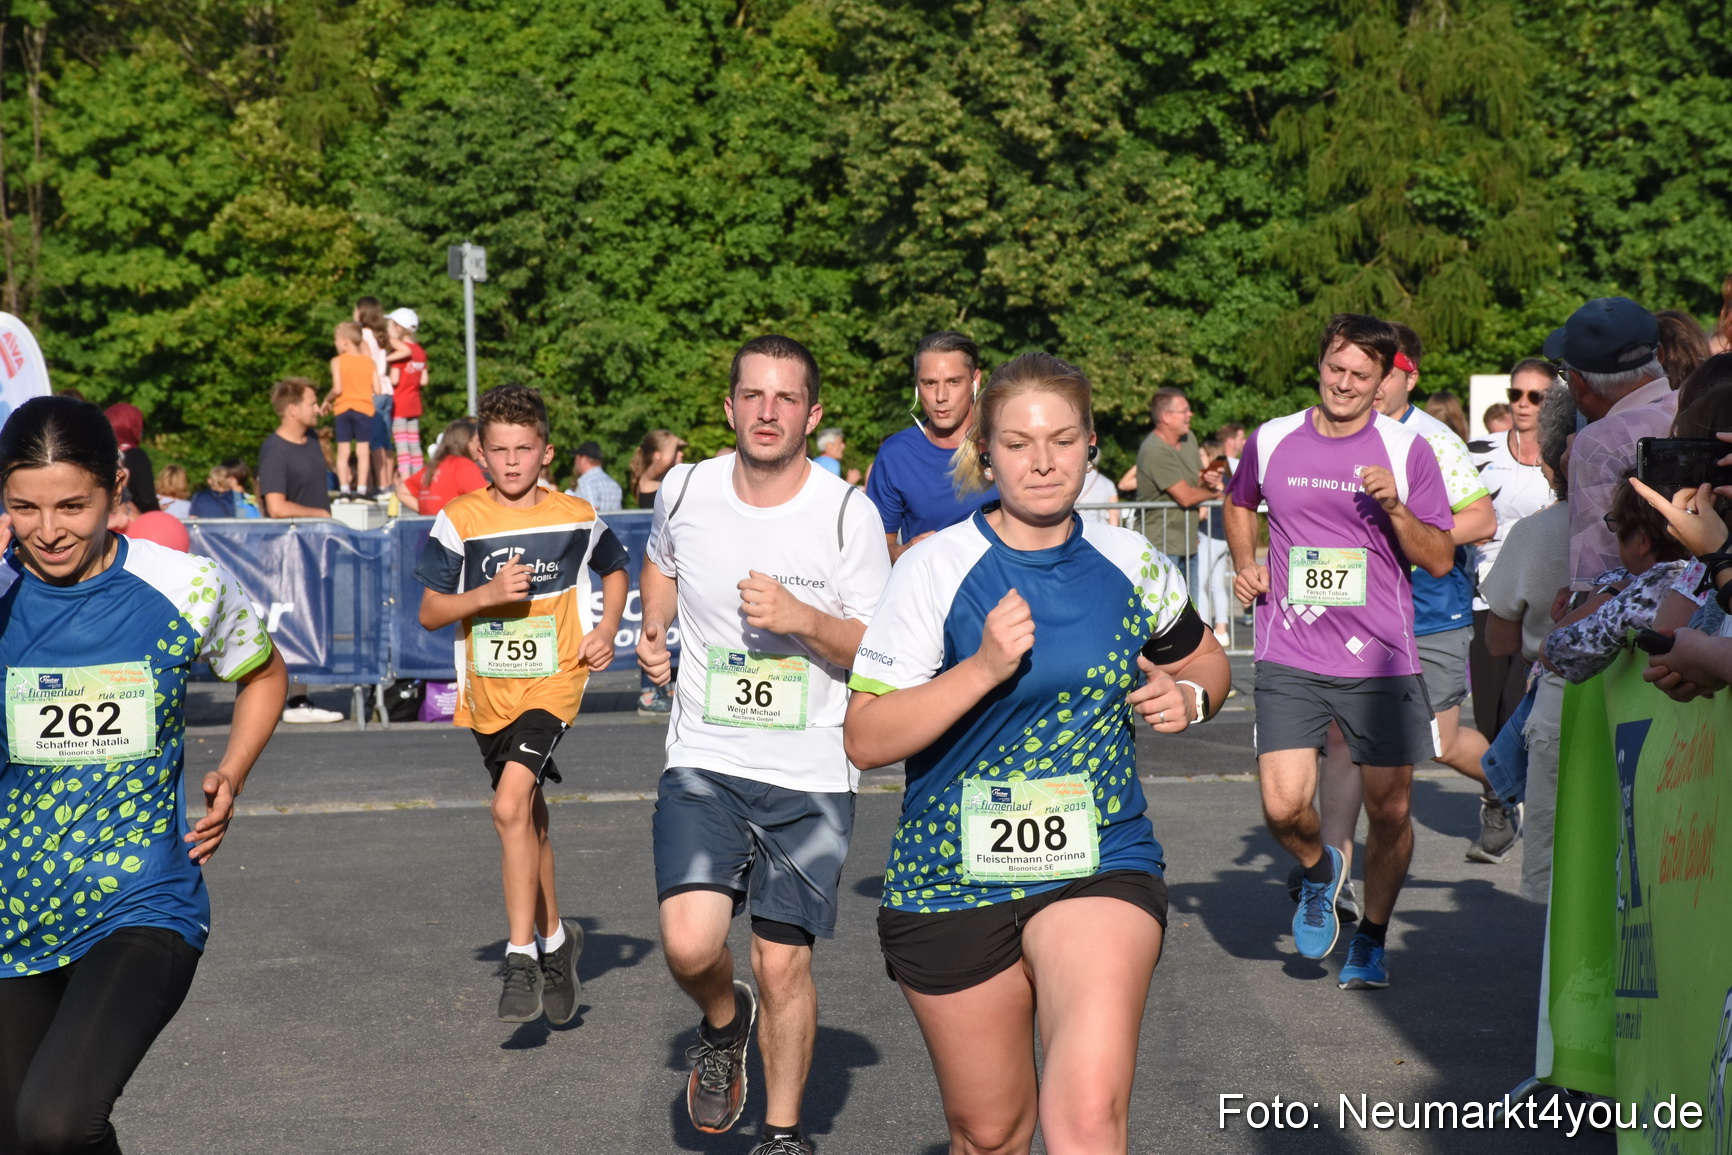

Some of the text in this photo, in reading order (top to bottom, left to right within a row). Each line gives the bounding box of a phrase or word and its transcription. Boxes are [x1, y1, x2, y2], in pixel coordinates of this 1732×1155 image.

[1287, 476, 1308, 487] WIR
[1311, 478, 1339, 490] SIND
[772, 574, 826, 589] auctores
[1305, 568, 1349, 589] 887
[490, 639, 537, 661] 759
[857, 643, 894, 667] ionorica
[28, 686, 86, 699] firmenlauf
[119, 689, 145, 699] 2019
[735, 678, 773, 708] 36
[727, 704, 781, 717] Weigl Michael
[732, 713, 756, 721] Auctores
[39, 701, 122, 739] 262
[36, 736, 130, 750] Schaffner Natalia
[58, 747, 107, 757] Bionorica SE
[981, 800, 1033, 812] firmenlauf
[1064, 801, 1087, 812] 2019
[990, 815, 1068, 853] 208
[976, 851, 1086, 864] Fleischmann Corinna
